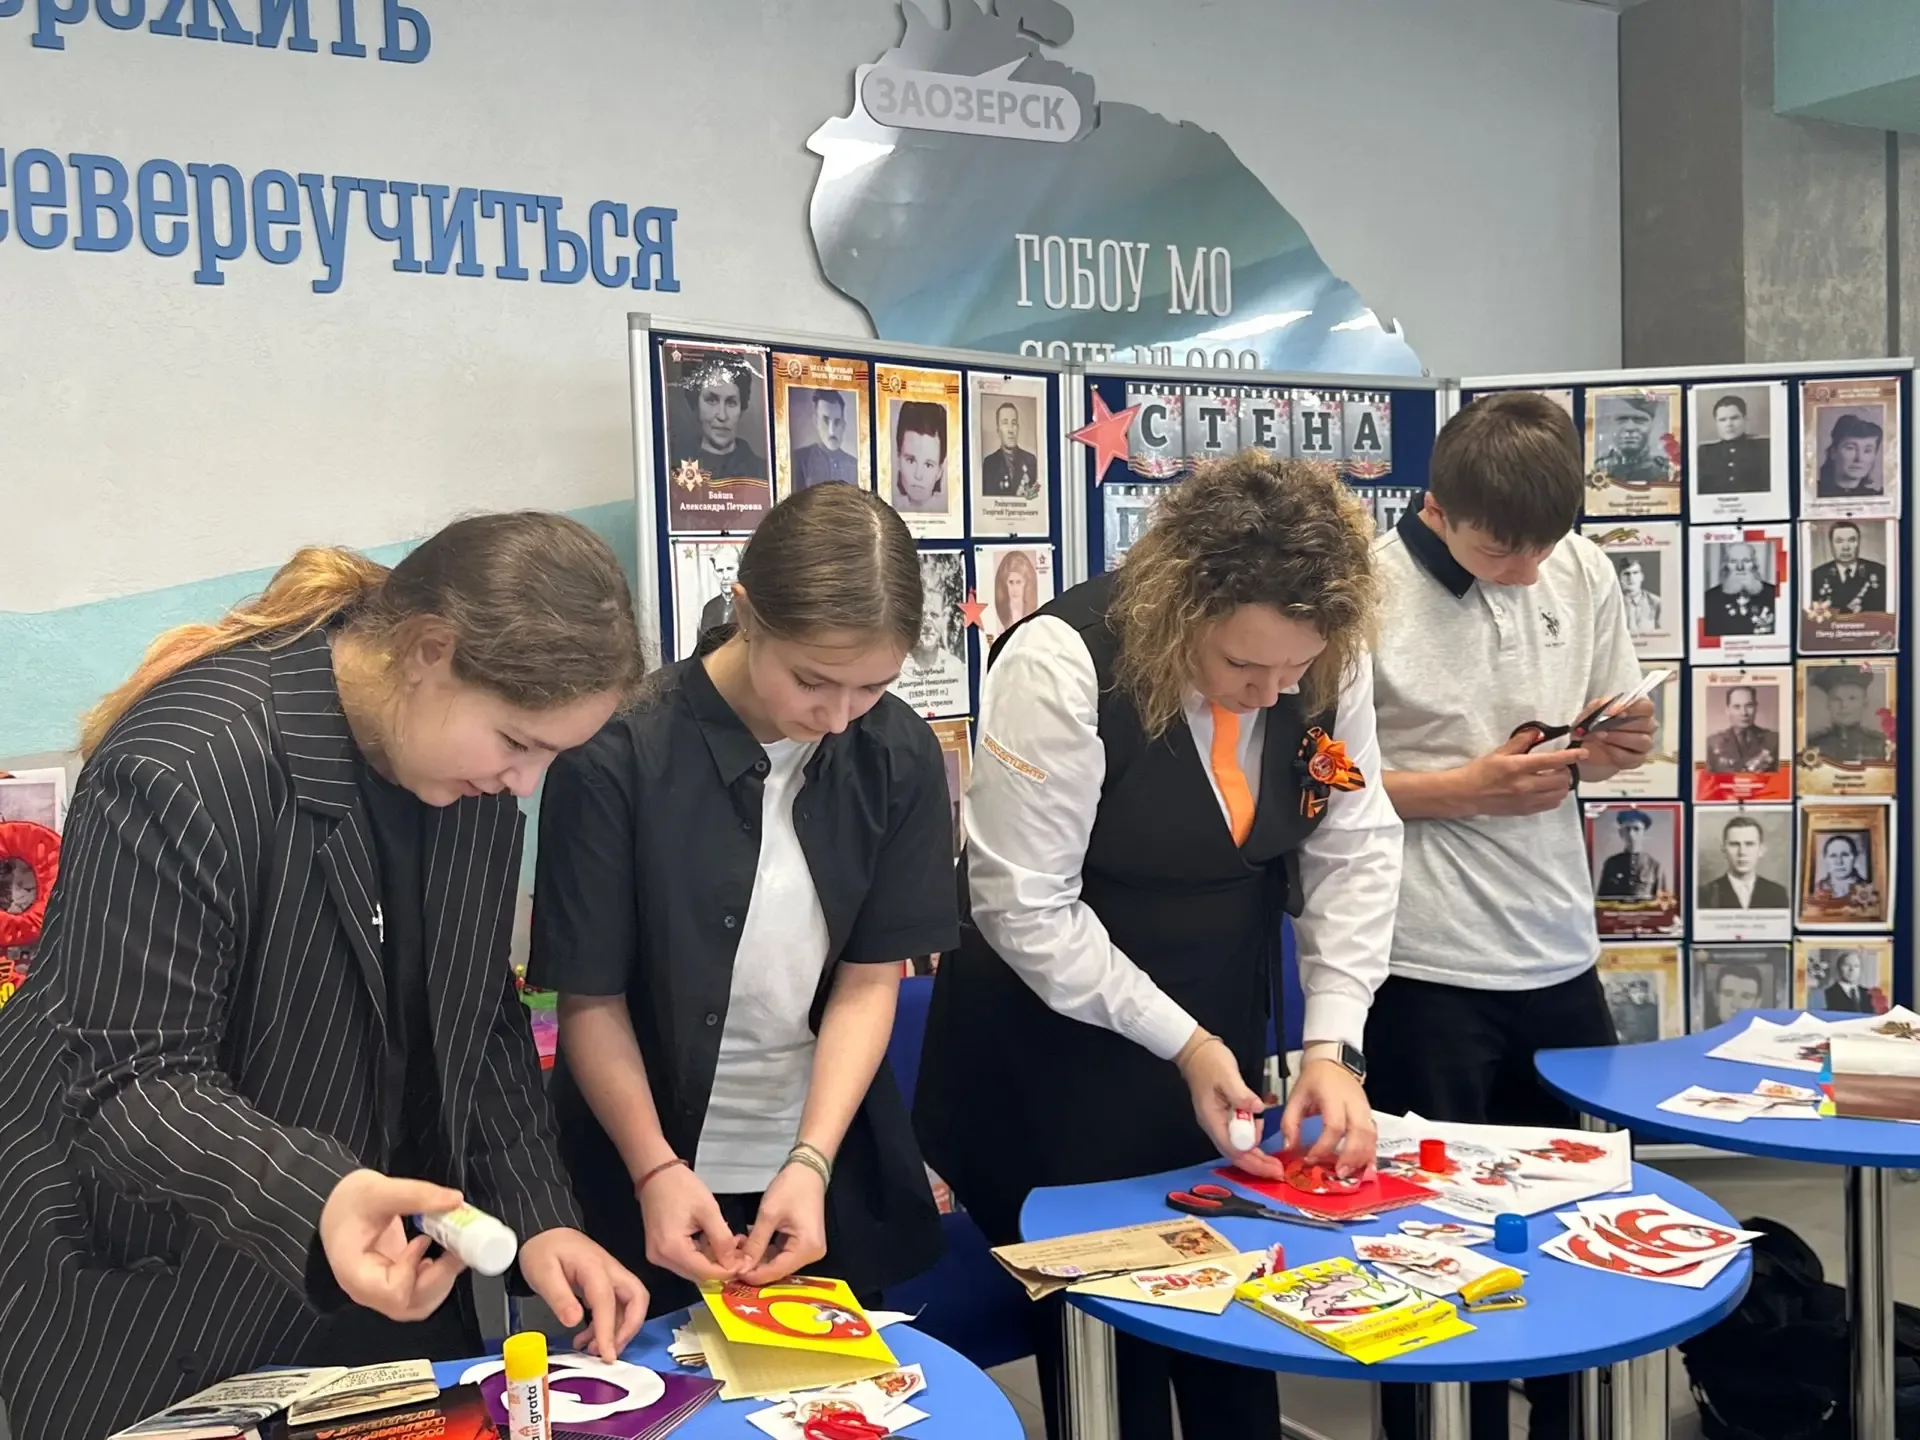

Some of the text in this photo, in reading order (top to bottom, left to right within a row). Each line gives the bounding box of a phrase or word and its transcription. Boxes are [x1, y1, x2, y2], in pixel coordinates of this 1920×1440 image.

[875, 77, 1066, 131] ЗАОЗЕРСК
[1015, 233, 1232, 317] ГОБОУ МО
[1139, 403, 1382, 451] СТЕНА
[680, 502, 762, 512] Александра Петровна
